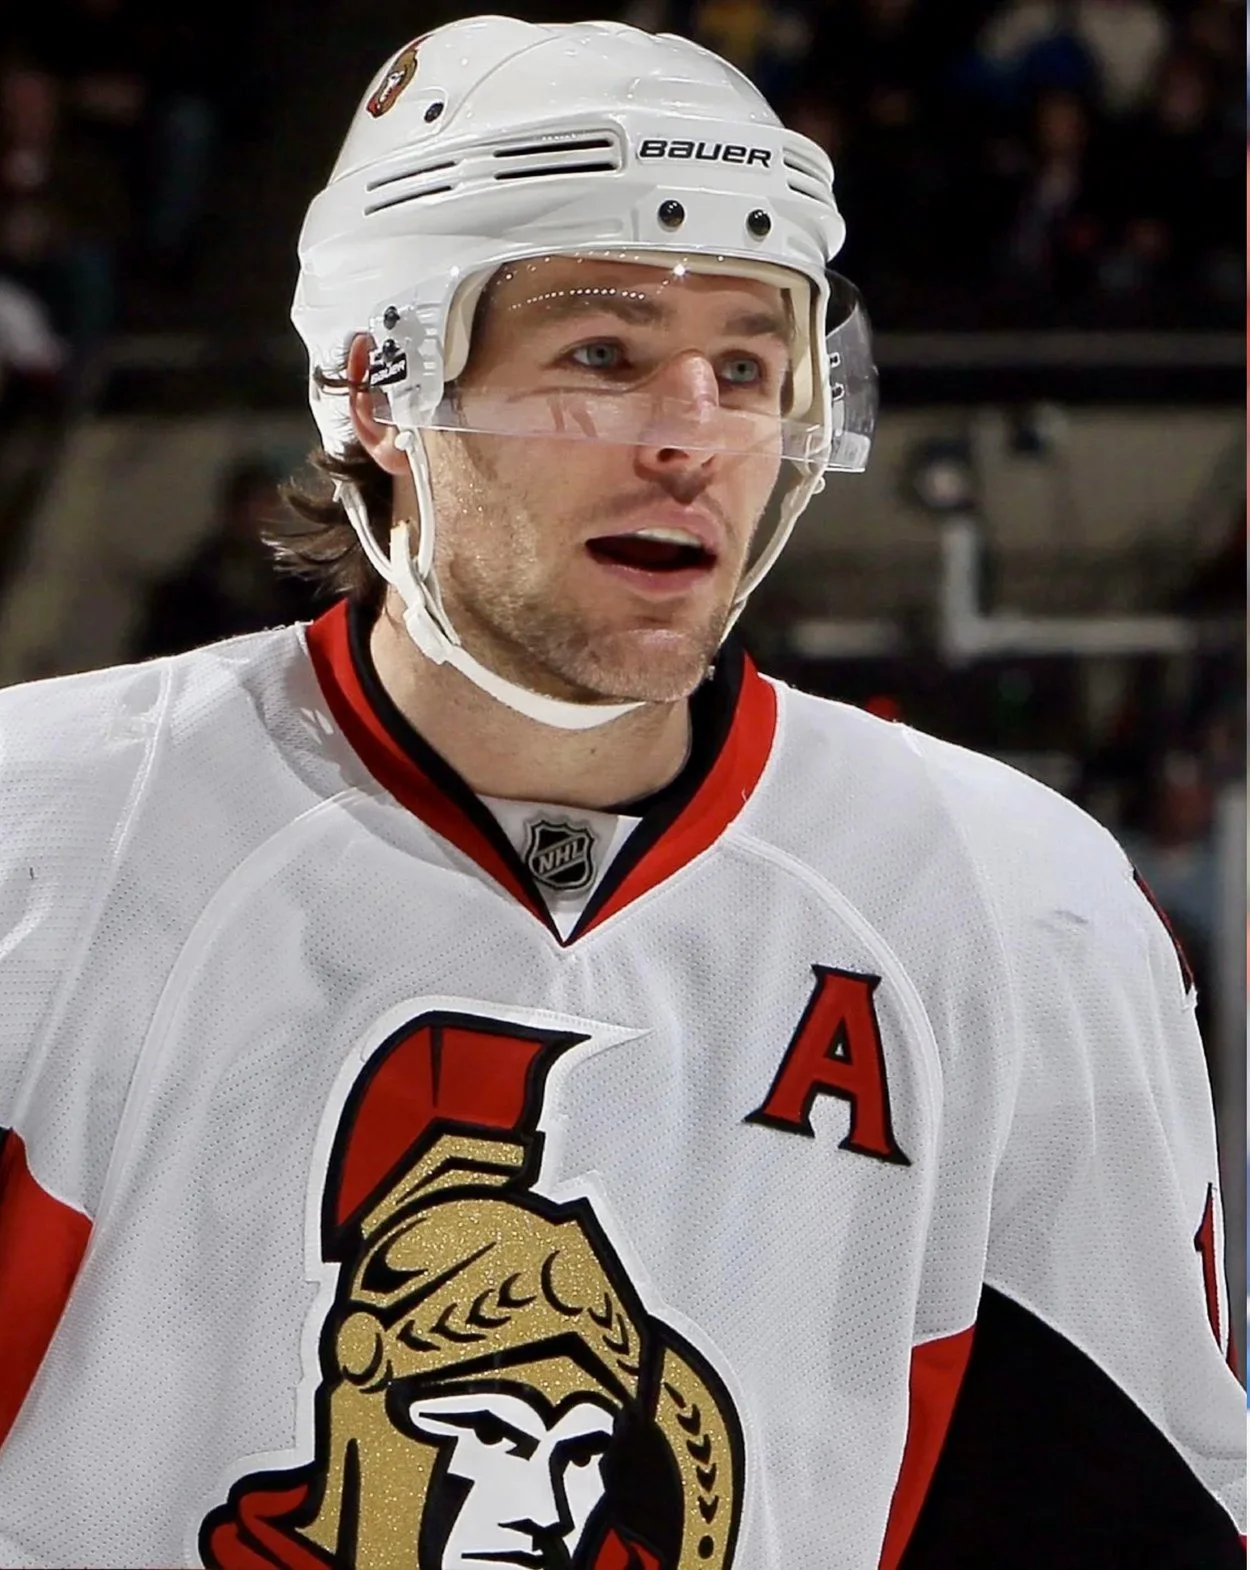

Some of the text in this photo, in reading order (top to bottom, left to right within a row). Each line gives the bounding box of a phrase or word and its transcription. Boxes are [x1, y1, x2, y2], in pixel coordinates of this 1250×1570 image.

[639, 139, 772, 168] BAUER
[539, 840, 583, 874] NHL
[742, 963, 912, 1167] A
